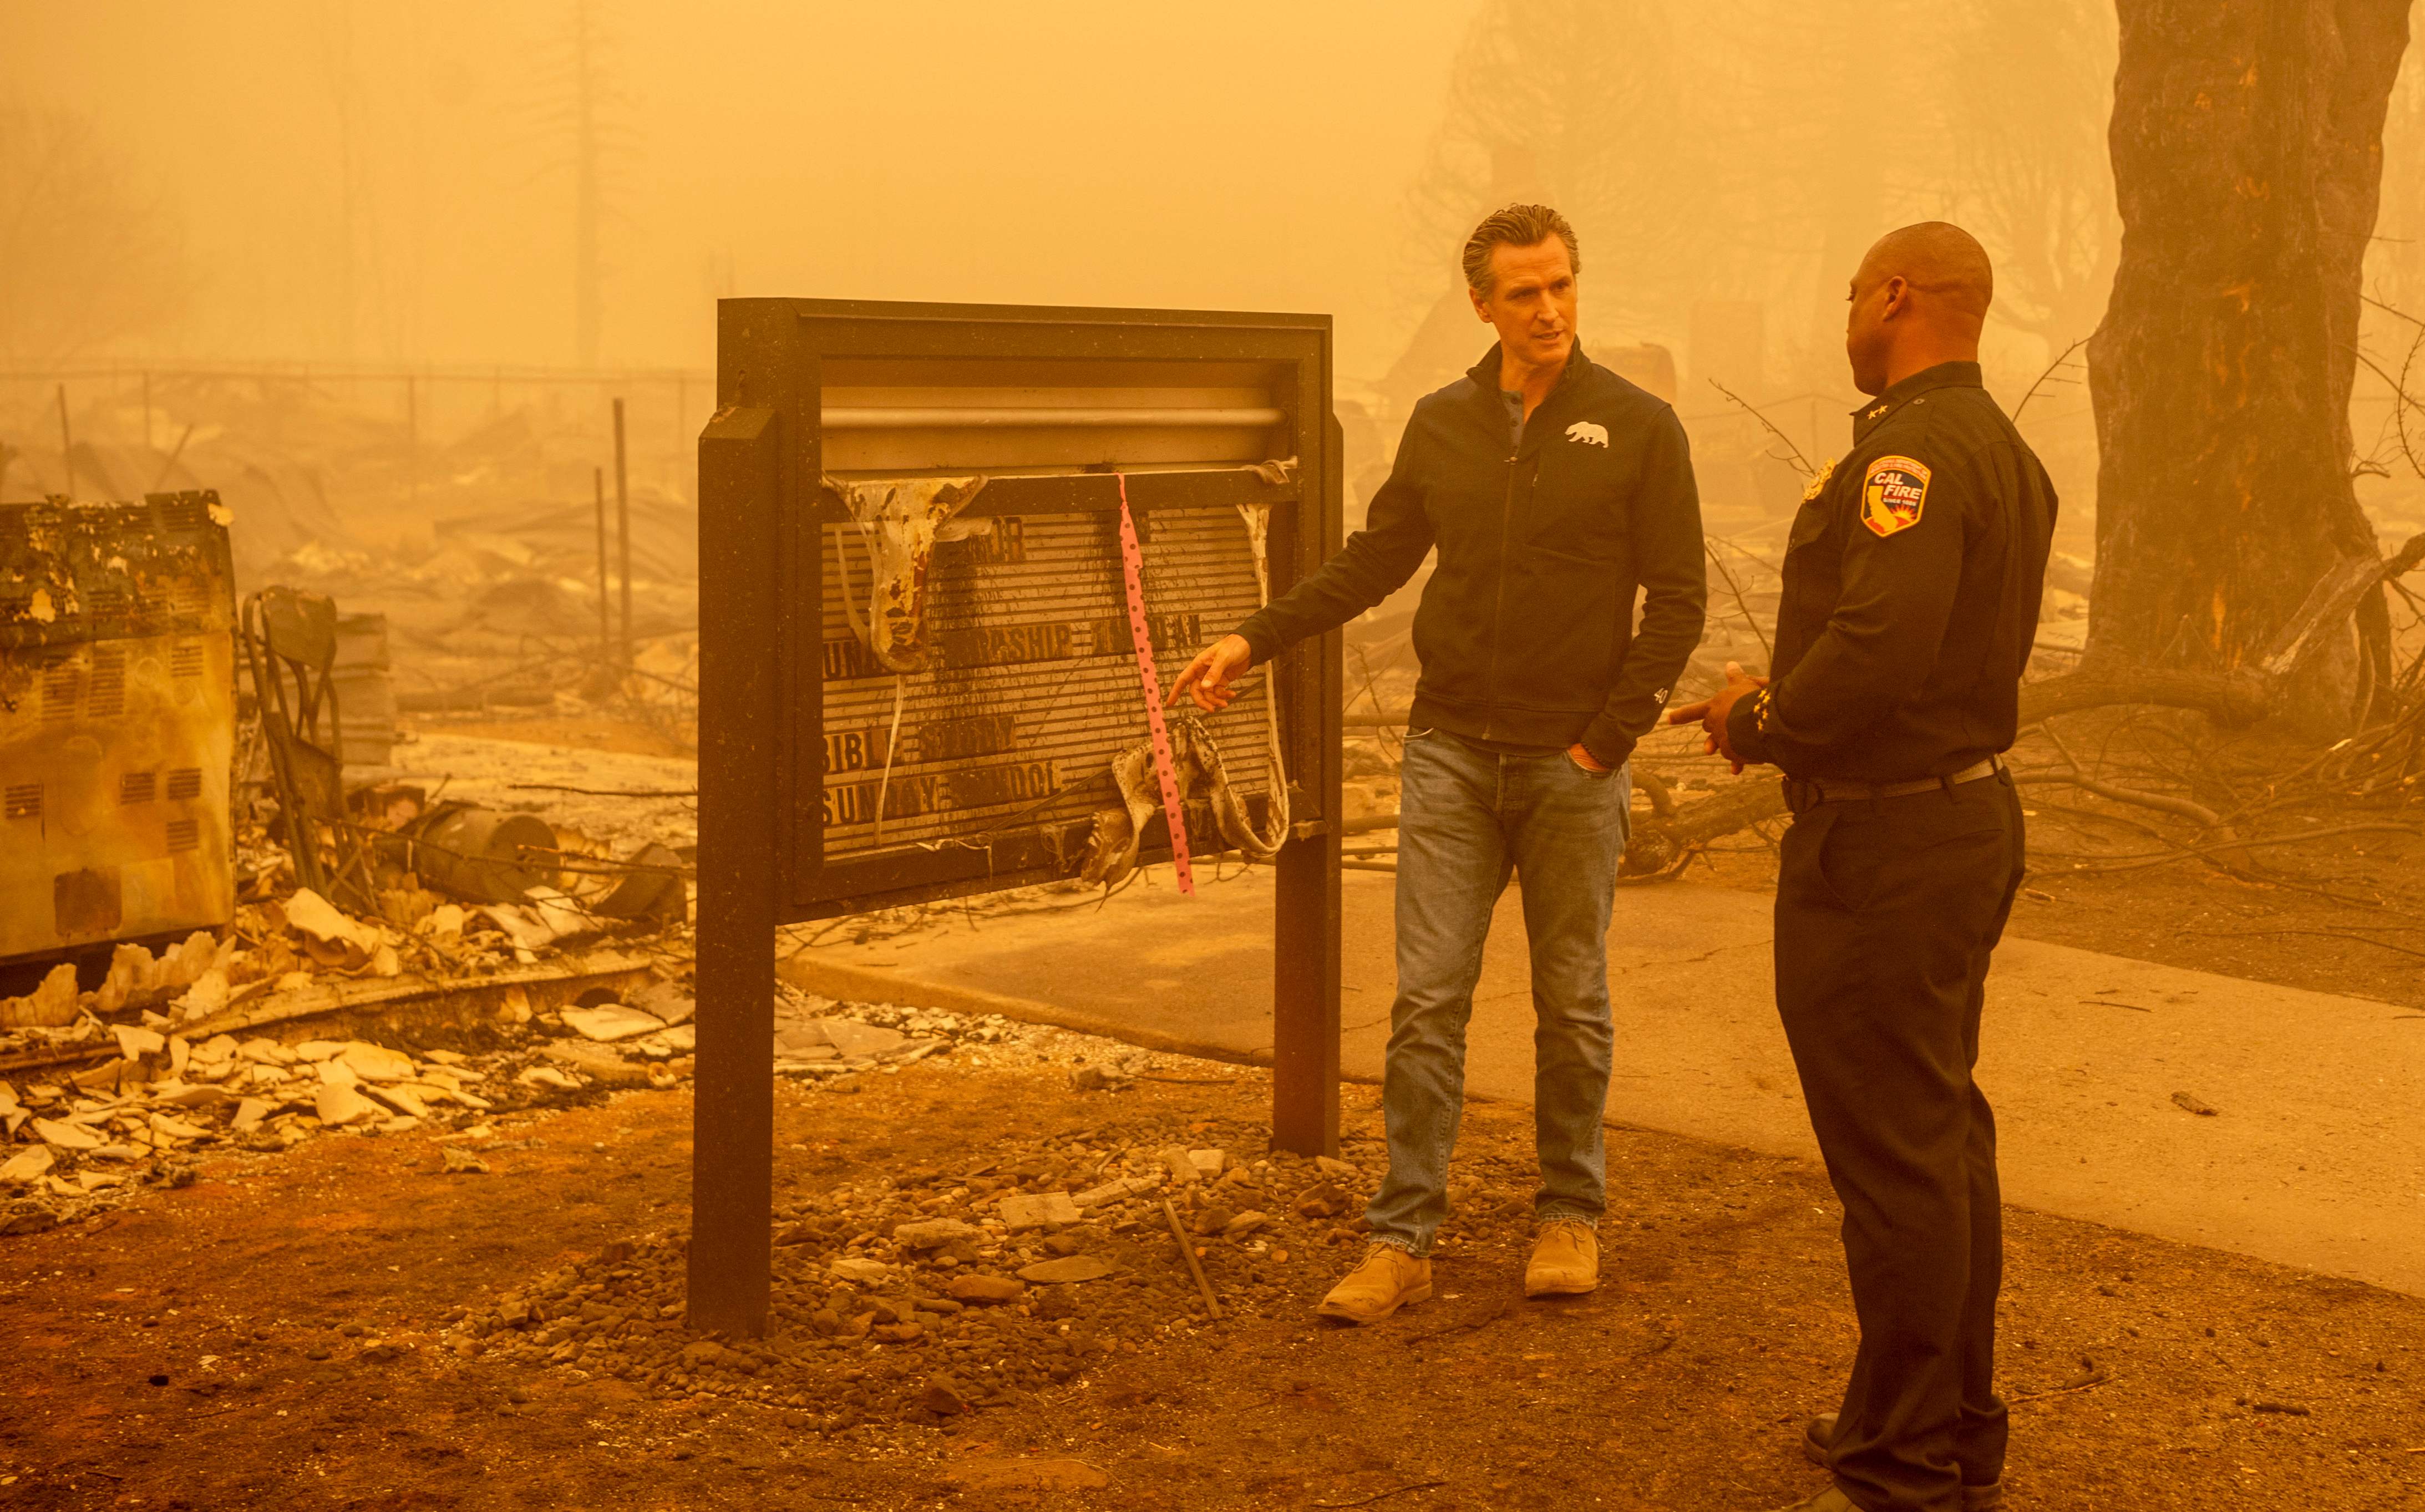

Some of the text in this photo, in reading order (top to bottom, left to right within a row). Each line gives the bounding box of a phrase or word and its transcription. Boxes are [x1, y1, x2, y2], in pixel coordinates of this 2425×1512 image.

[1874, 472, 1904, 485] CAL
[1884, 485, 1922, 499] FIRE
[1653, 687, 1668, 704] 40
